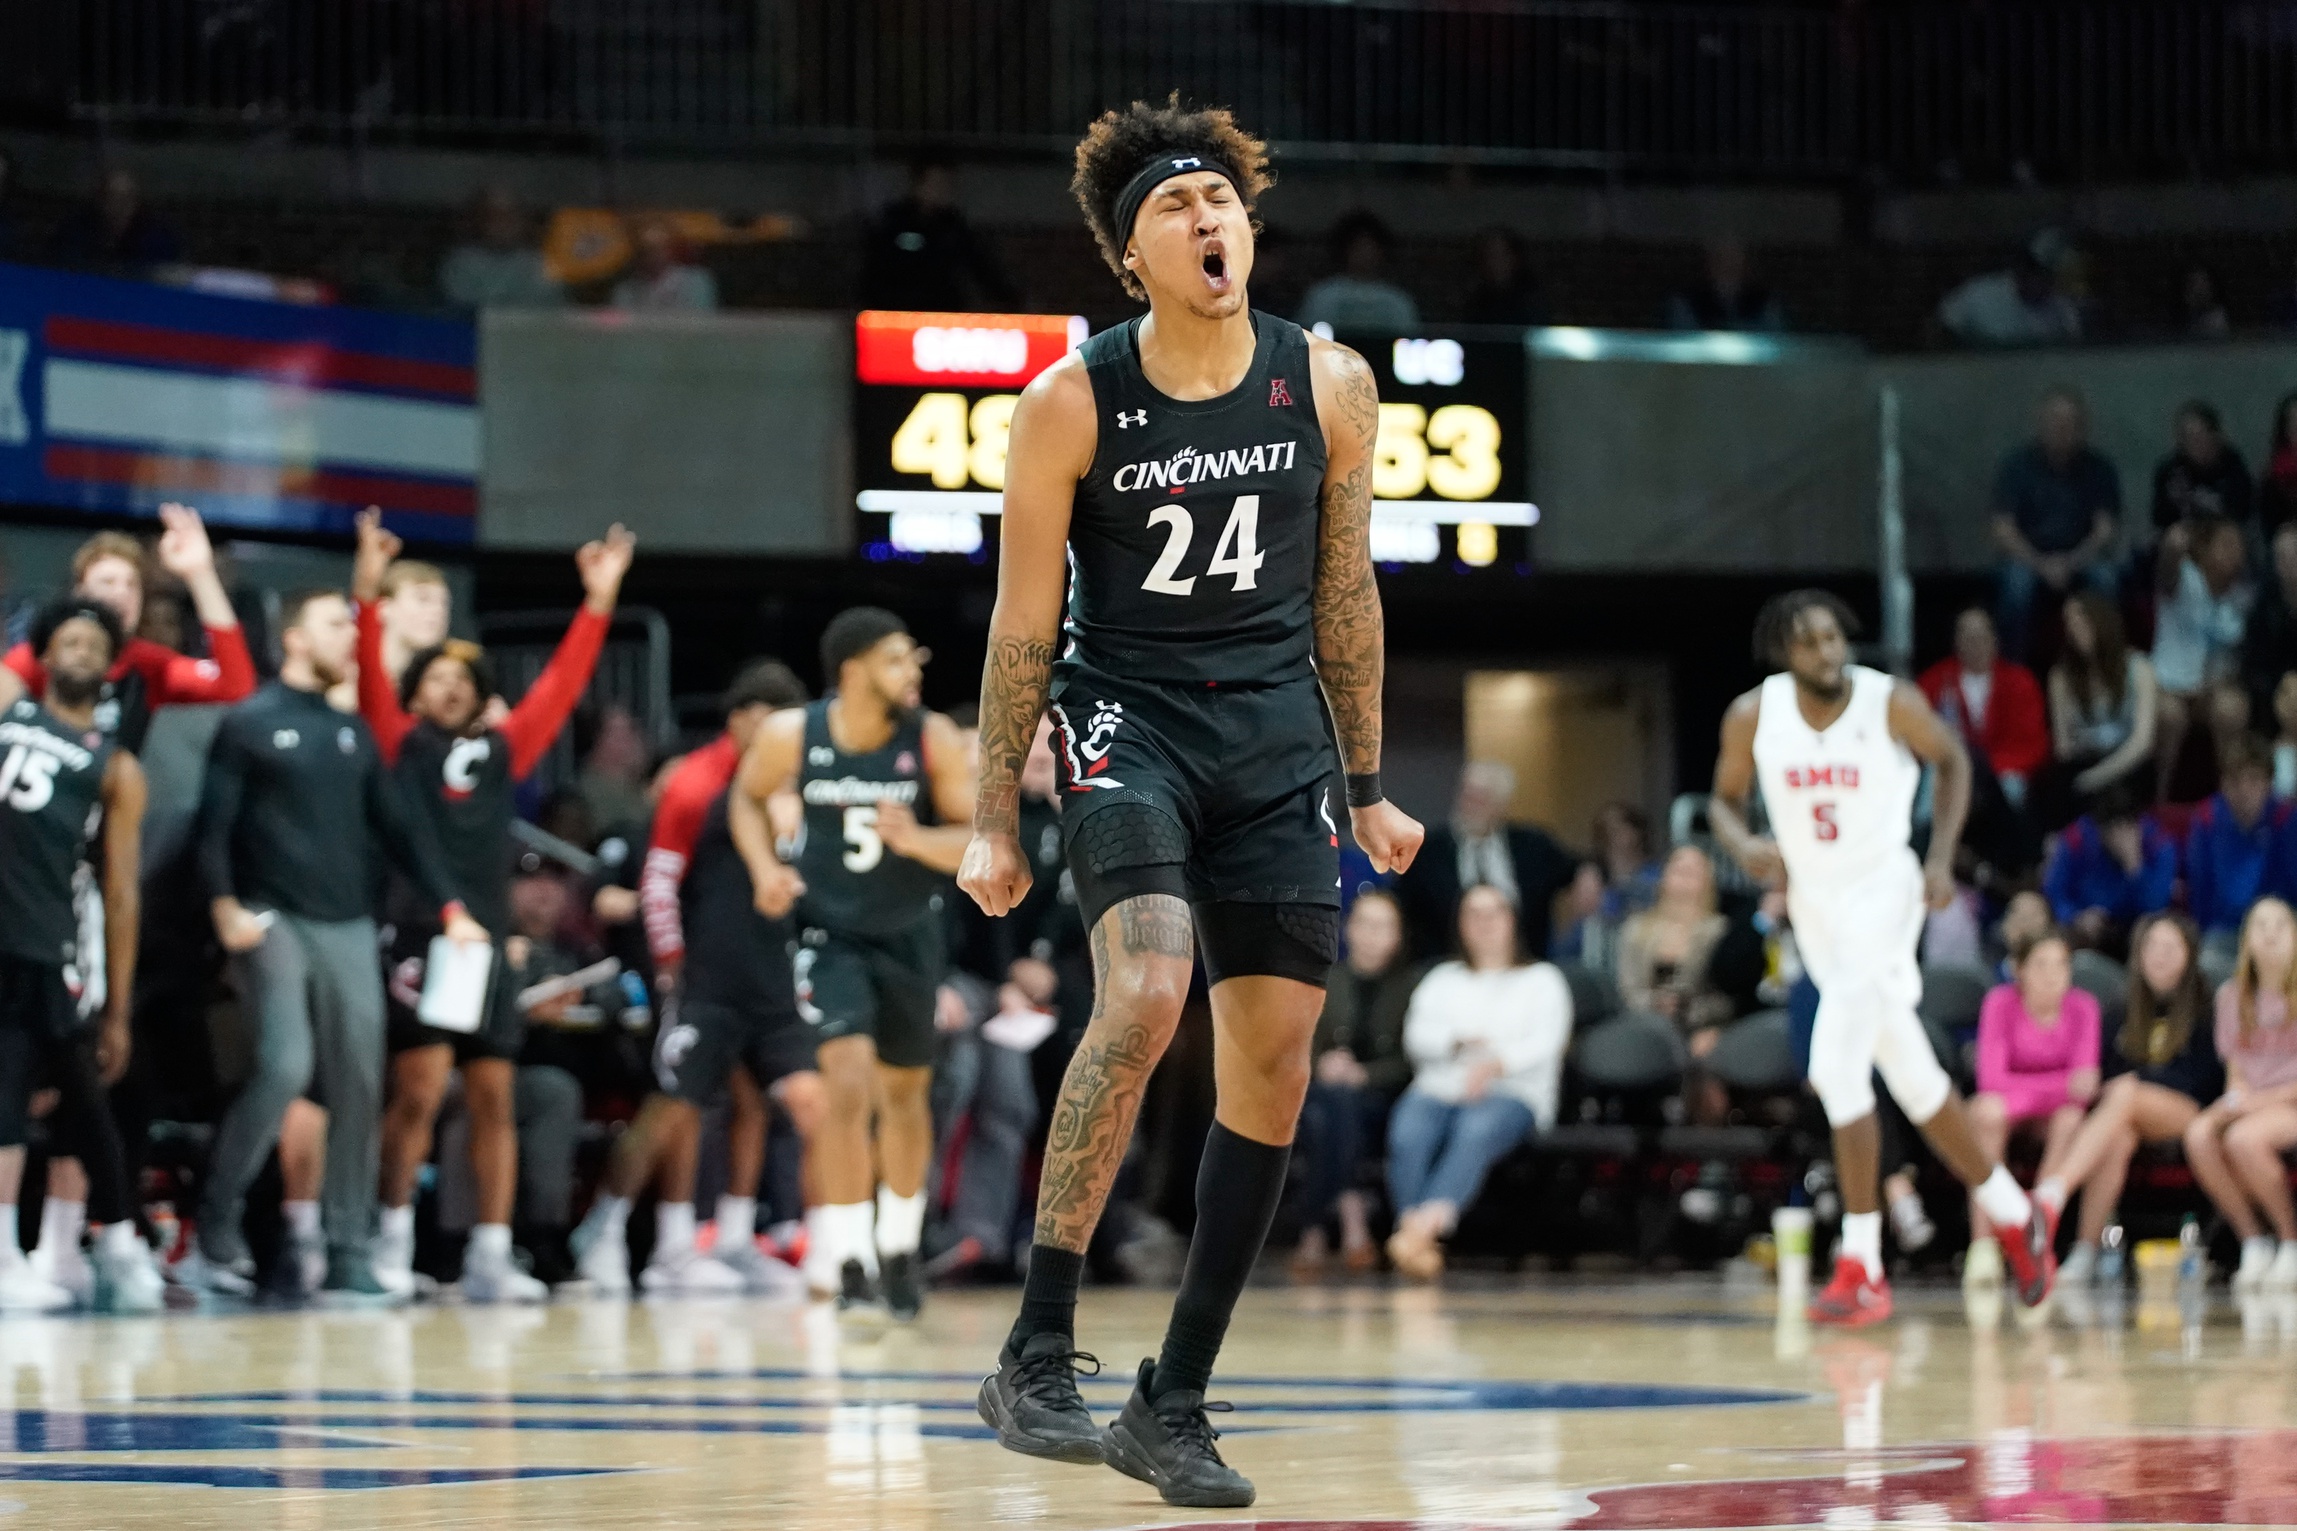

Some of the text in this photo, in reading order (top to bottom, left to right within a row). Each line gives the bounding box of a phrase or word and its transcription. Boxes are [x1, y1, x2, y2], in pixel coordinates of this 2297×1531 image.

[1113, 441, 1296, 492] CINCINNATI
[1140, 495, 1266, 596] 24
[0, 745, 60, 812] 15
[842, 805, 883, 874] 5
[1812, 802, 1838, 842] 5
